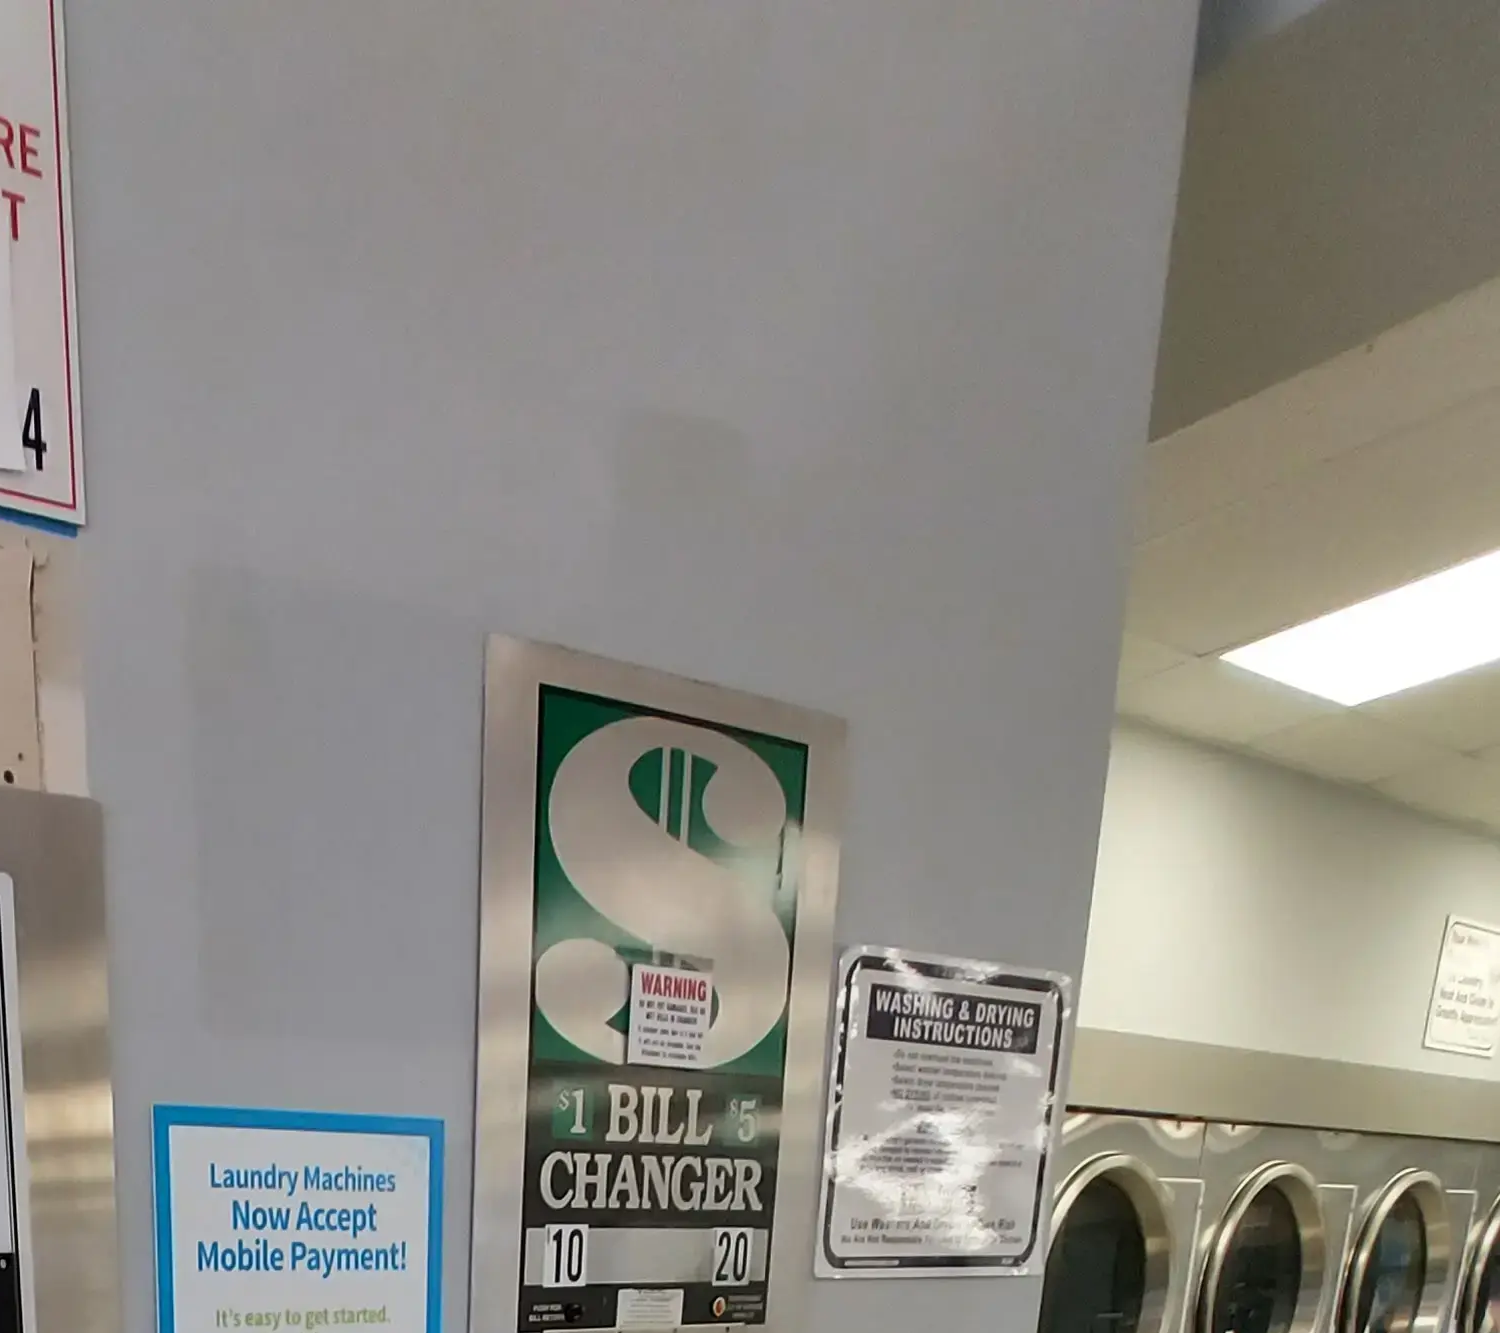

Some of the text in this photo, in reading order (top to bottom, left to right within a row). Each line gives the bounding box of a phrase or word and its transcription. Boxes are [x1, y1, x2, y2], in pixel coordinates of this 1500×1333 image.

[641, 971, 706, 1002] WARNING
[876, 989, 1034, 1028] WASHING & DRYING
[893, 1016, 1013, 1048] INSTRUCTIONS
[605, 1083, 713, 1145] BILL
[210, 1163, 396, 1196] Laundry Machines
[540, 1151, 763, 1211] CHANGER
[232, 1200, 377, 1238] Now Accept
[197, 1239, 406, 1278] Mobile Payment!
[553, 1229, 584, 1283] 10
[715, 1231, 748, 1282] 20
[216, 1305, 391, 1330] It's easy to get started.
